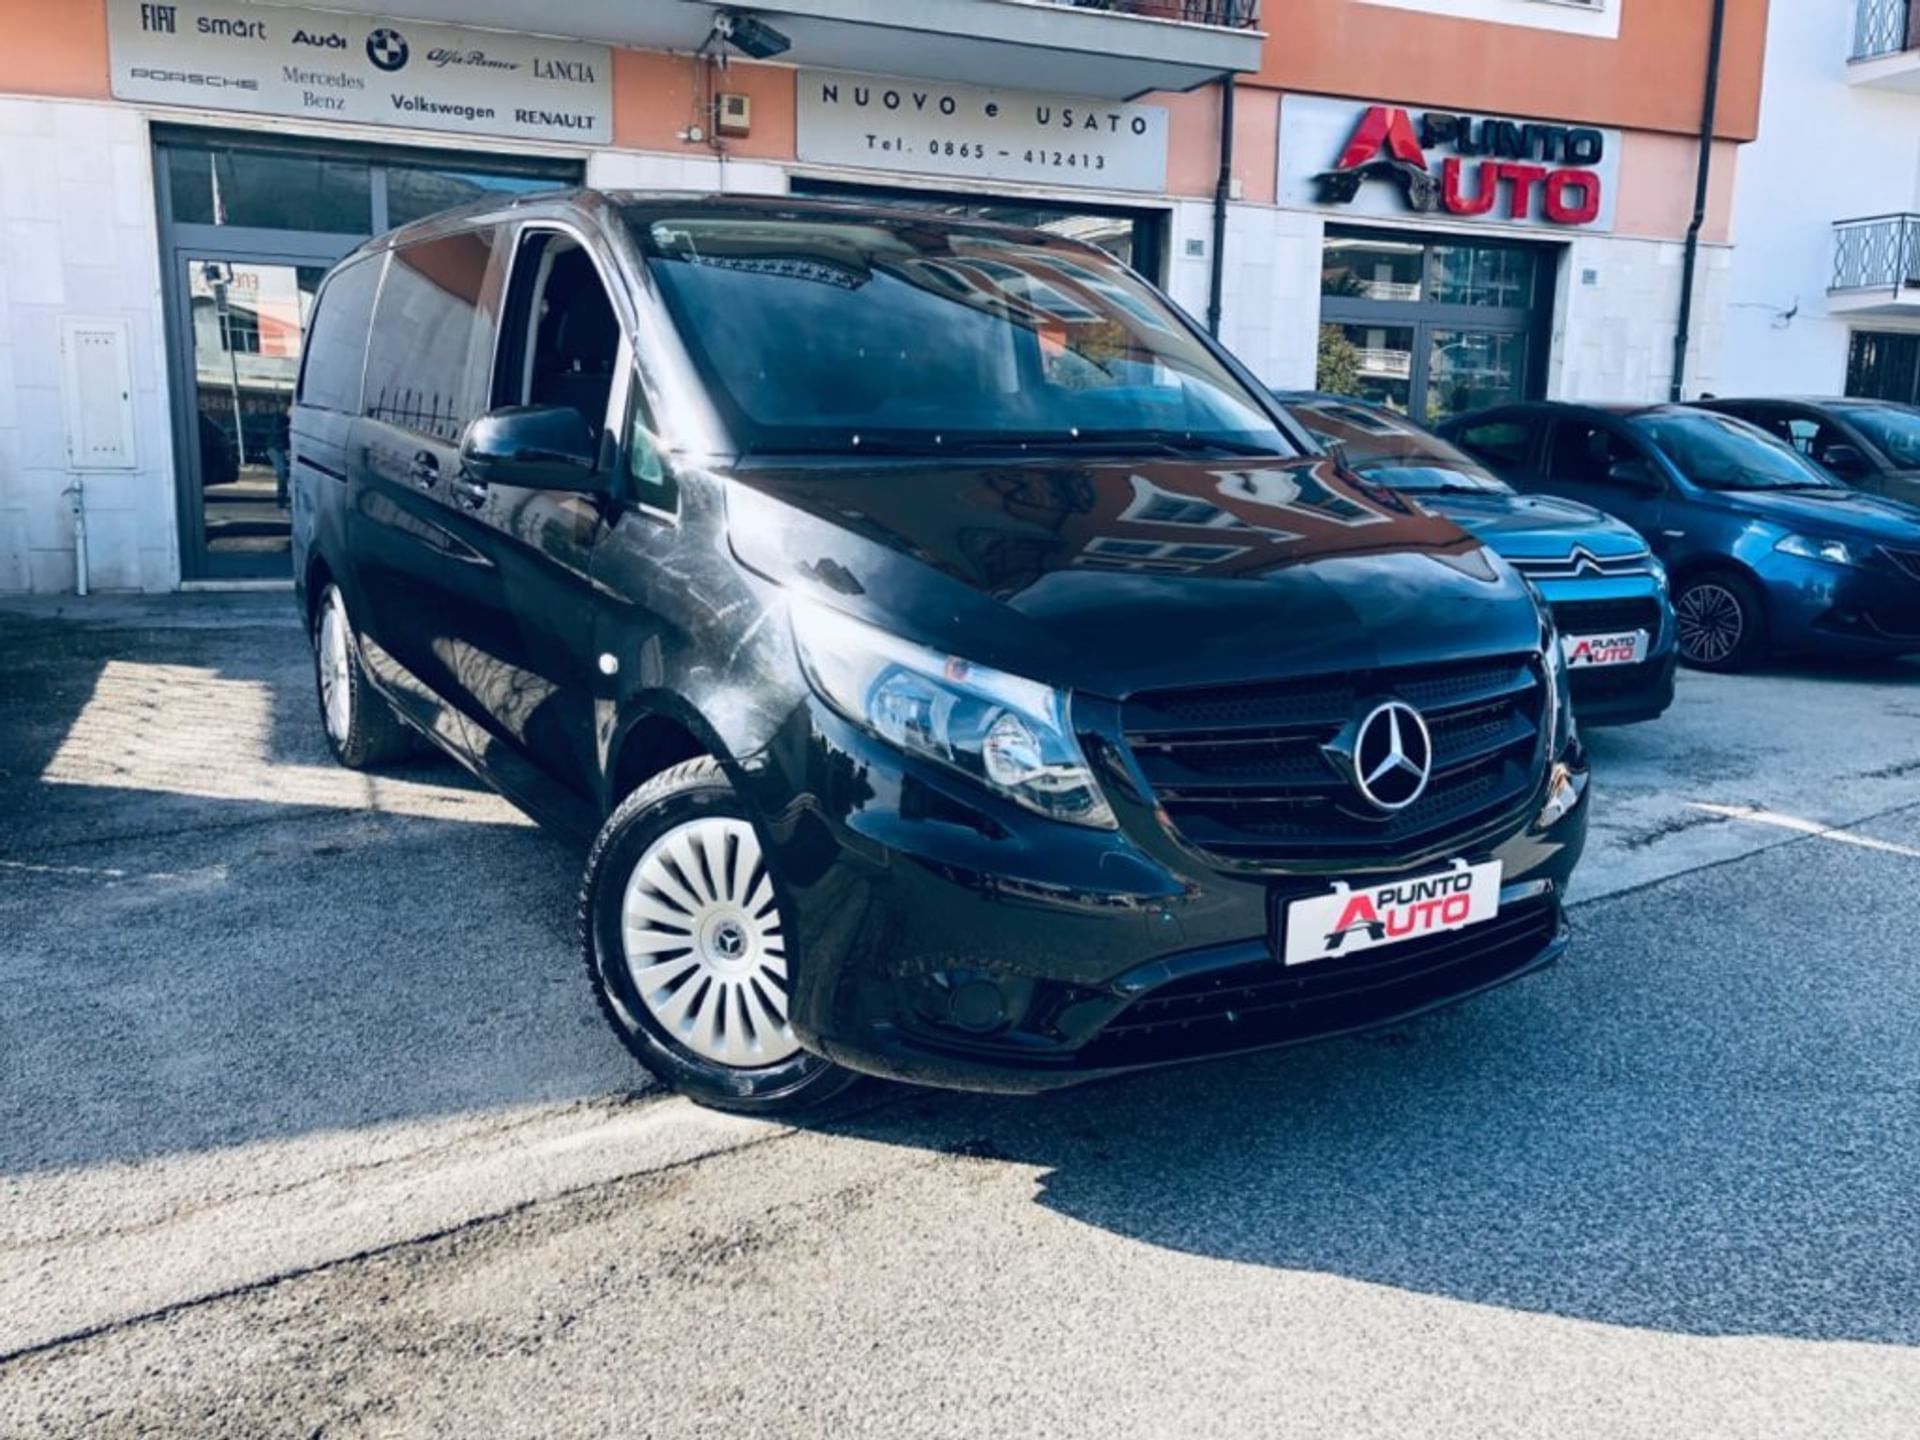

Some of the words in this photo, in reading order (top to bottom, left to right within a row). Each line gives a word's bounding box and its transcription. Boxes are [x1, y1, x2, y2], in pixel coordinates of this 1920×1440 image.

[141, 4, 177, 33] FIAT
[197, 16, 267, 40] smart
[292, 30, 347, 49] Audi
[131, 67, 258, 90] PORSCHE
[282, 65, 365, 90] Mercedes
[533, 58, 595, 83] LANCIA
[303, 91, 346, 110] Benz
[391, 93, 495, 120] Volkswagen
[822, 85, 956, 116] NUOVO
[985, 102, 998, 117] e
[1037, 106, 1147, 135] USATO
[515, 108, 596, 129] RENAULT
[866, 135, 913, 152] Tel.
[929, 140, 985, 160] 0865
[1023, 149, 1105, 170] 412413
